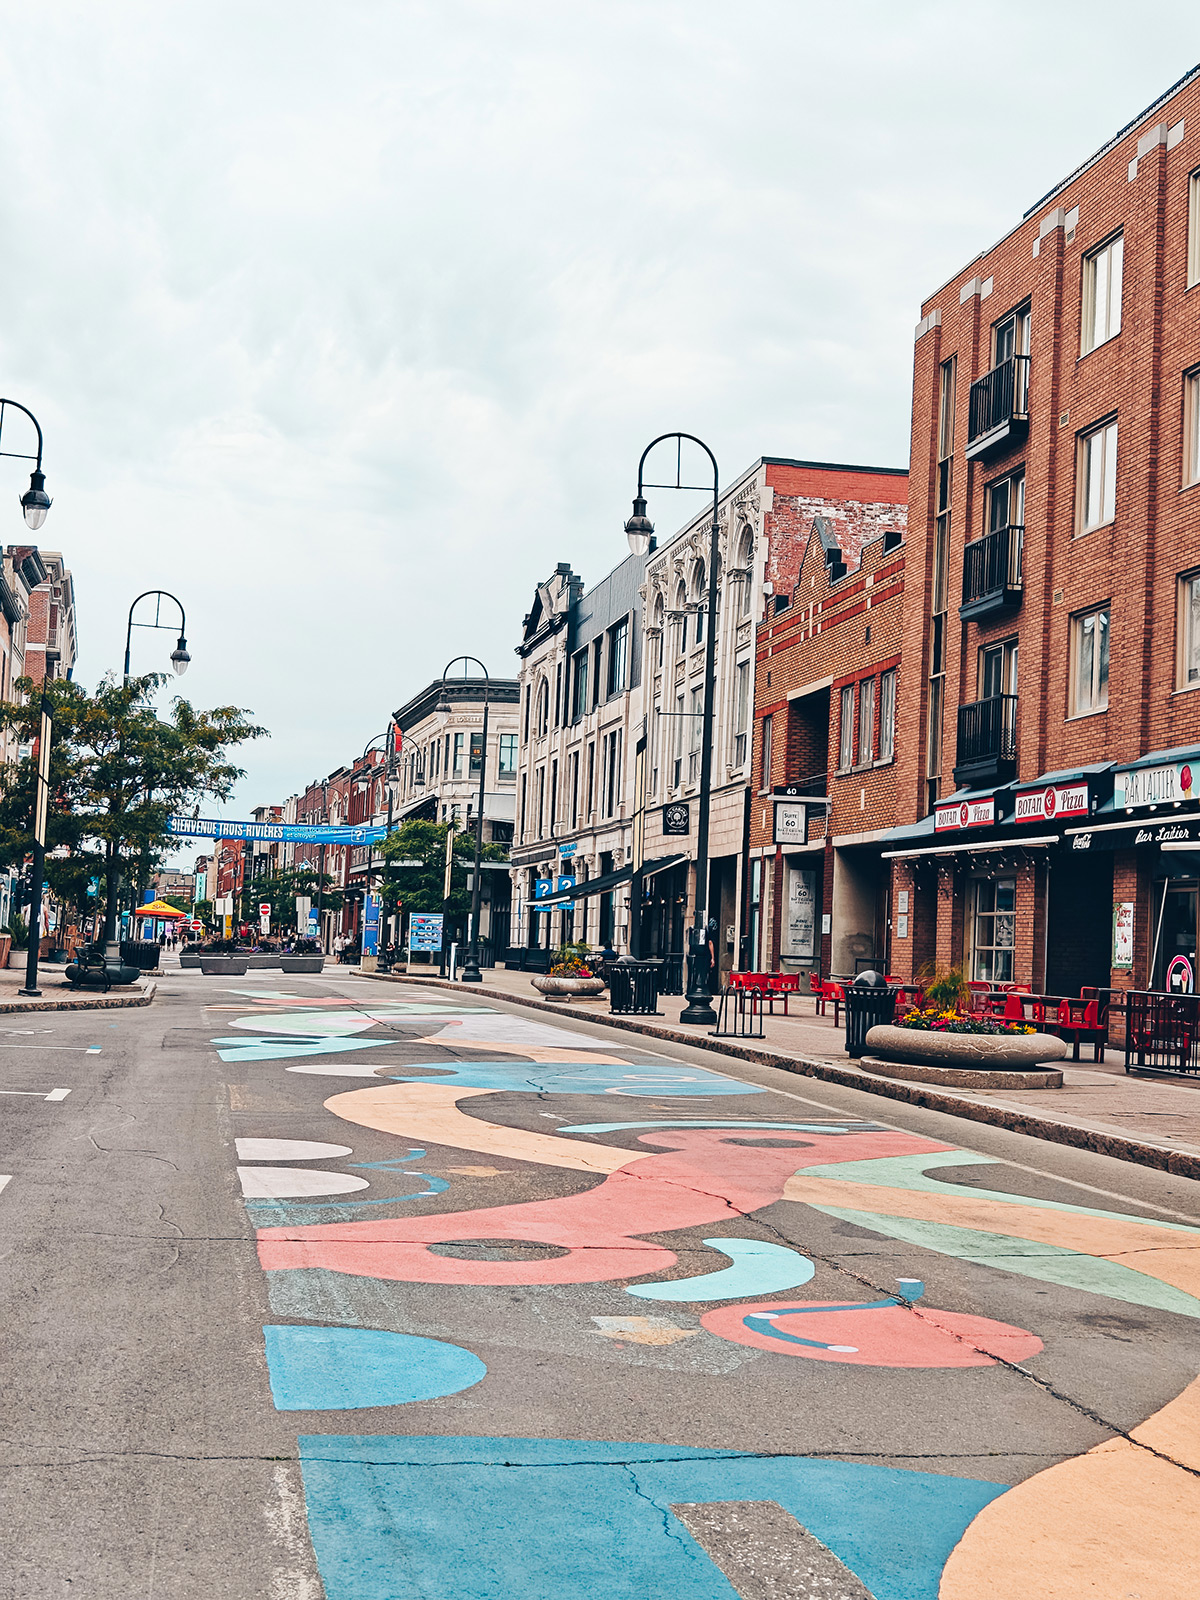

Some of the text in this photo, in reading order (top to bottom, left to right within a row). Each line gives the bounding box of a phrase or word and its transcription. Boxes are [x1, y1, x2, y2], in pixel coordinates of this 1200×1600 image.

[1124, 769, 1175, 805] BAR LAITIER
[1018, 791, 1084, 816] BOTAN Pizza
[938, 806, 990, 825] BOTAN Pizza
[1135, 825, 1190, 845] Bar Laitier
